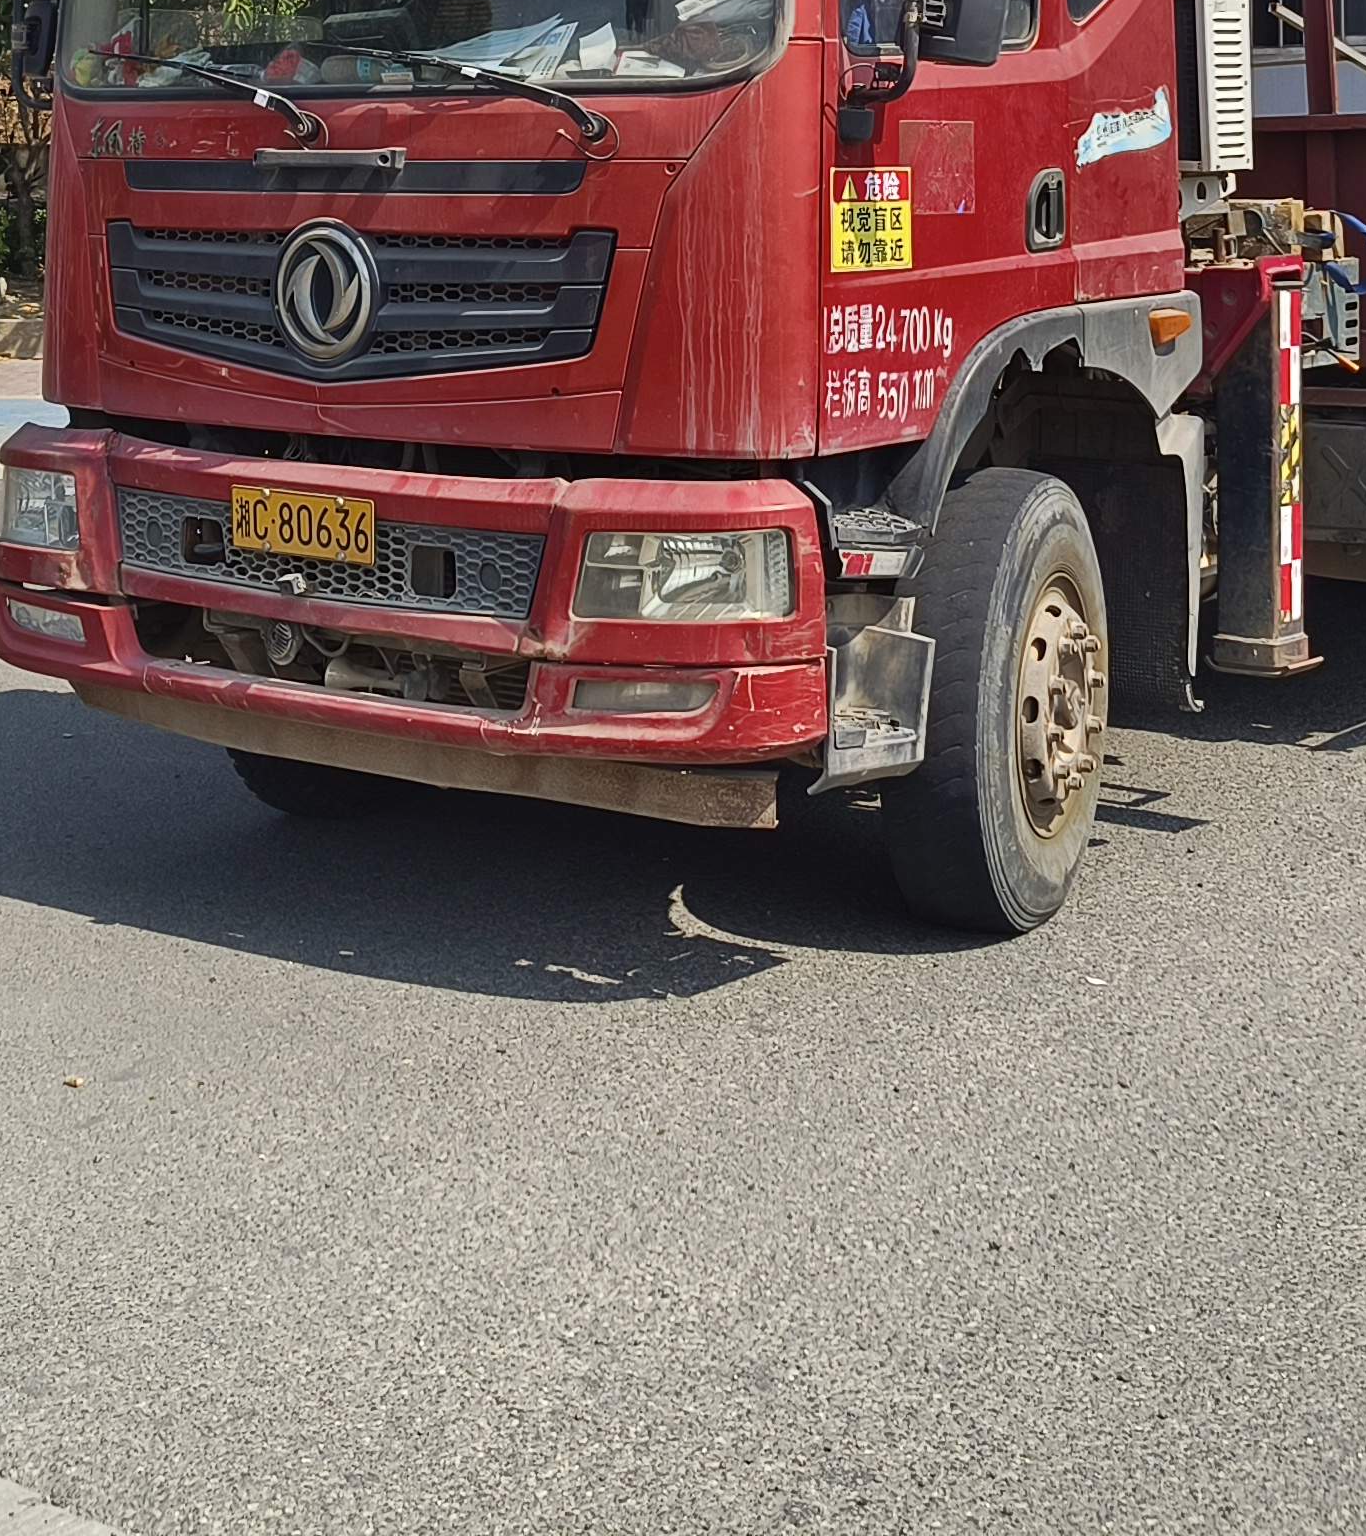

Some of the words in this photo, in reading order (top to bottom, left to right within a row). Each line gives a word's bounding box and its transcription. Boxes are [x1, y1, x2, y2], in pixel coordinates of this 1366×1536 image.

[864, 171, 901, 201] 危险
[840, 206, 903, 233] 视觉盲区
[840, 238, 904, 265] 请勿靠近
